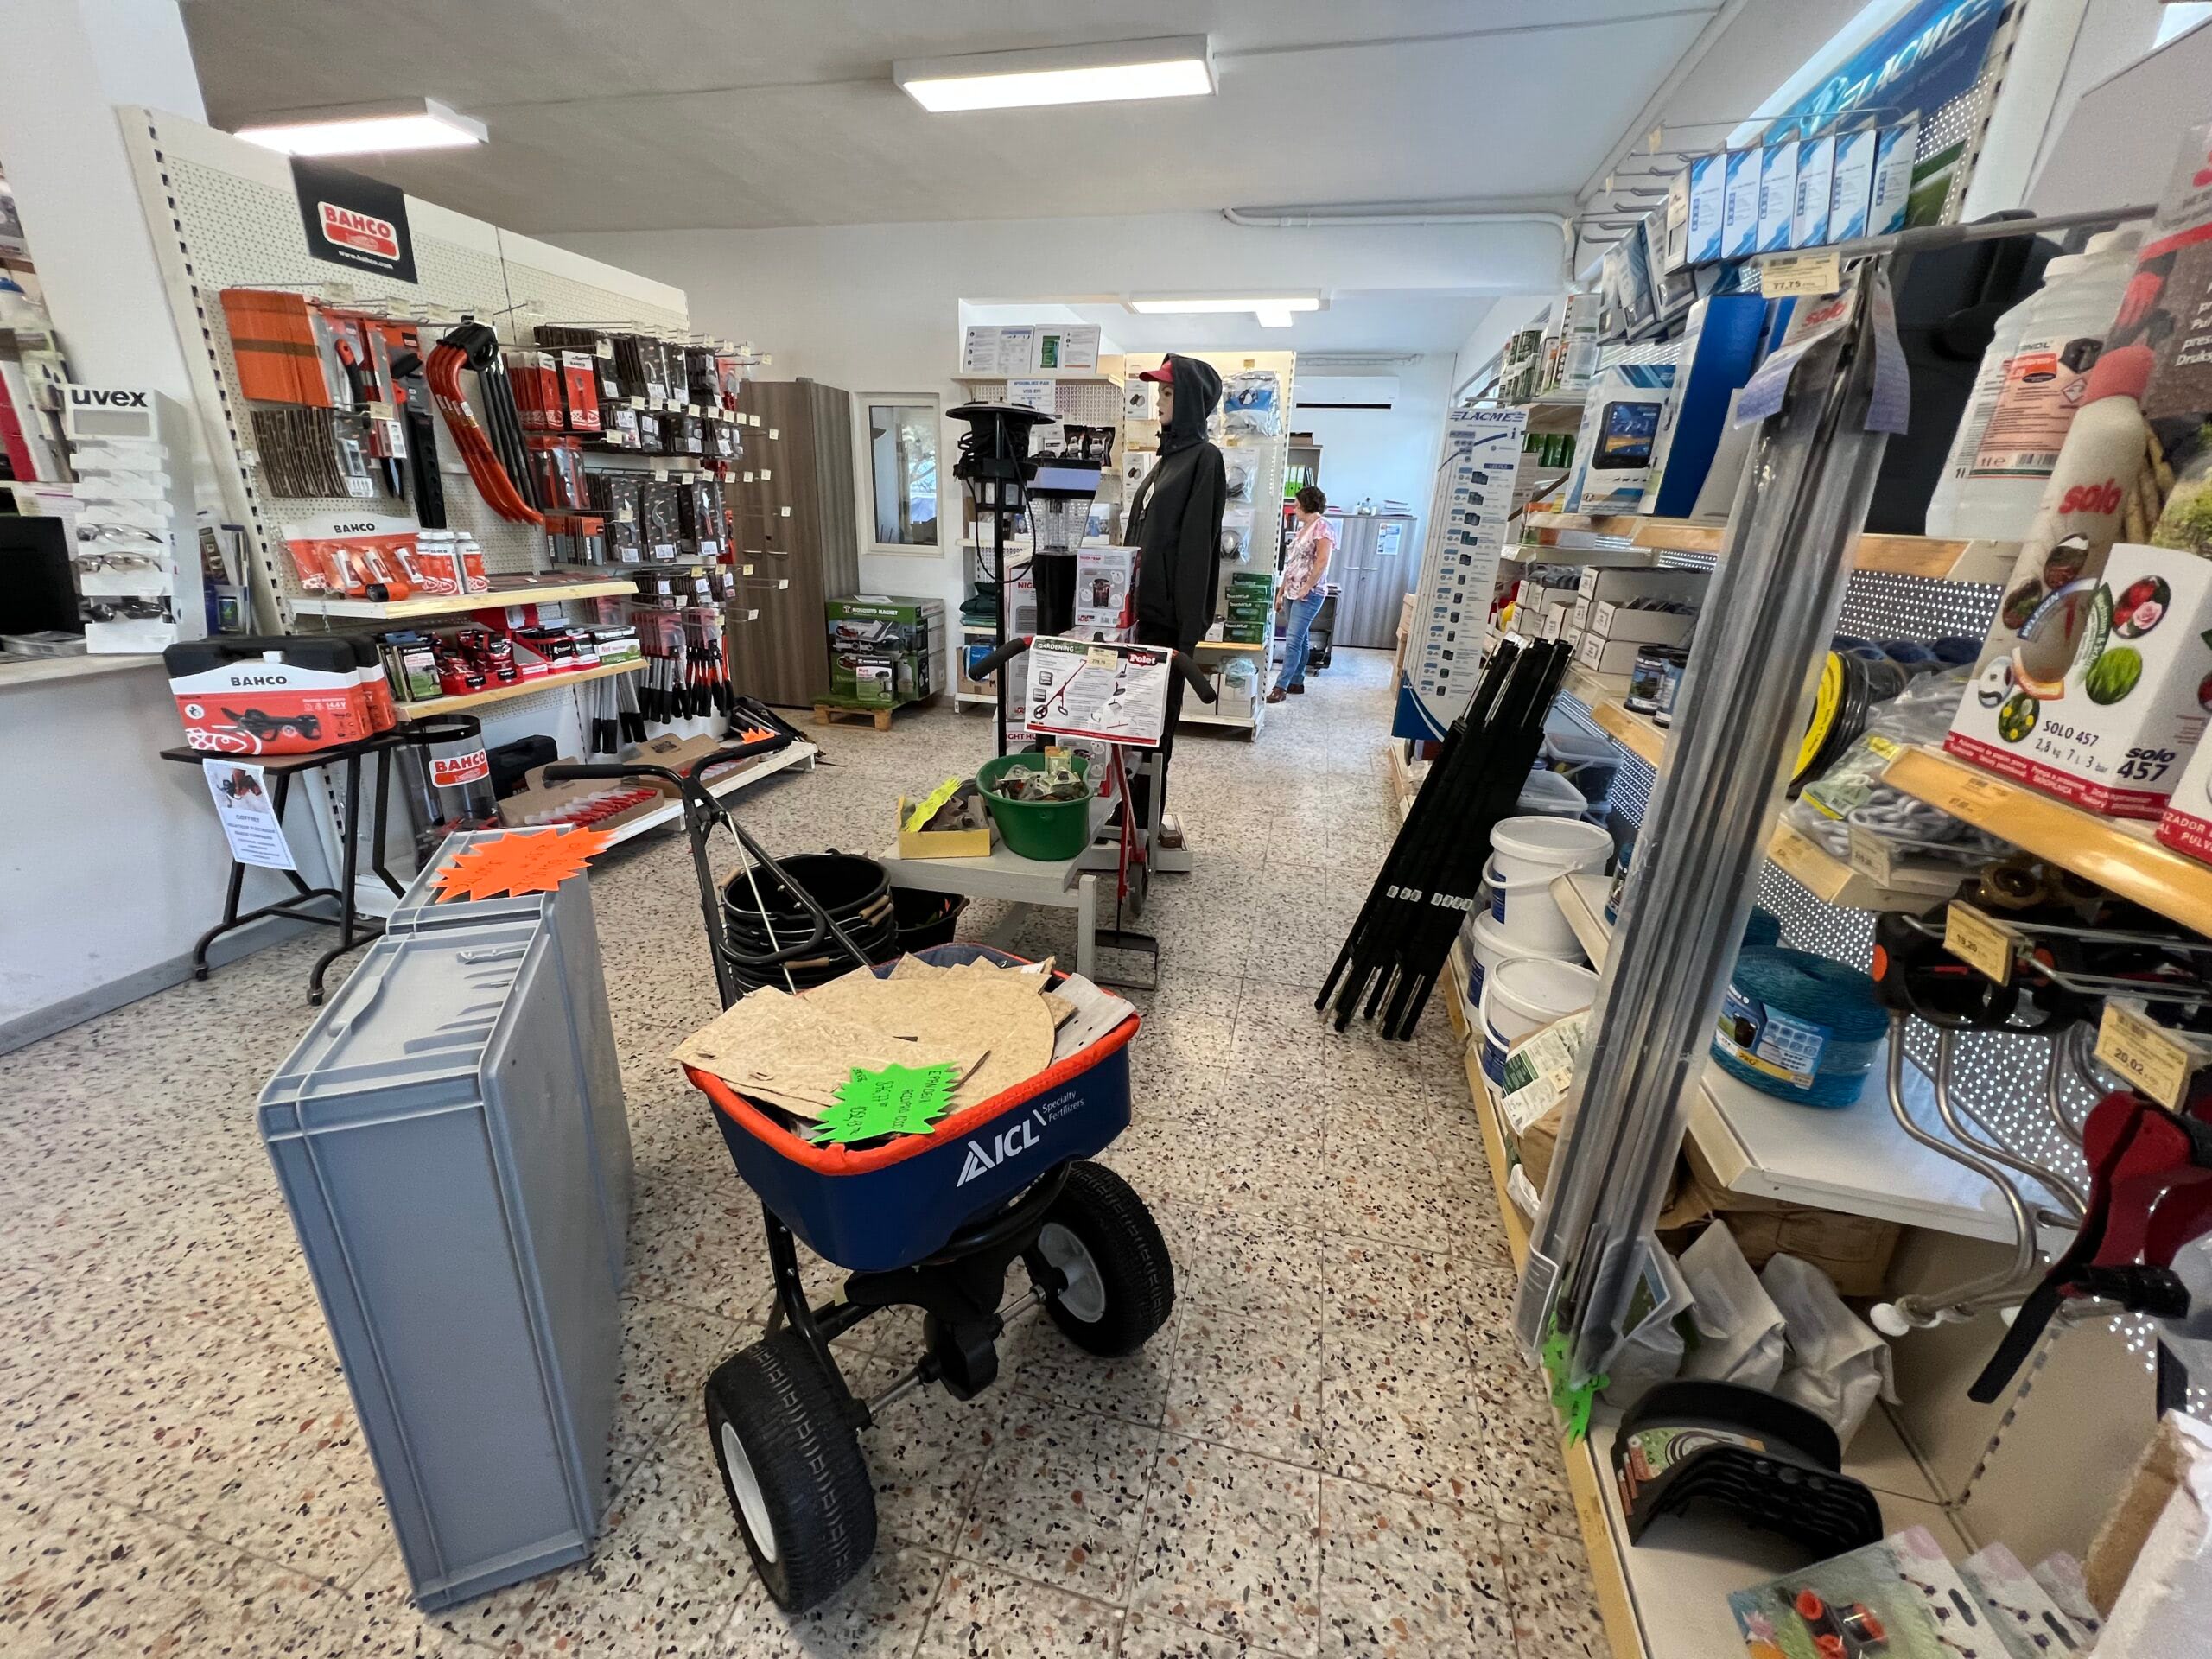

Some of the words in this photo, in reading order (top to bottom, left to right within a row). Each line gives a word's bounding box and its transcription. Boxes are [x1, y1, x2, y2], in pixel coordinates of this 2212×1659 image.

[323, 206, 391, 238] BAHCO
[2181, 335, 2212, 353] pres
[72, 389, 148, 407] uvex
[1460, 411, 1514, 422] LACME
[2058, 478, 2122, 515] solo
[334, 523, 376, 534] BAHCO
[1037, 642, 1075, 653] GARDENING
[1129, 653, 1157, 664] Polet
[230, 677, 289, 688] BAHCO
[2043, 720, 2075, 740] SOLO
[2075, 731, 2100, 747] 457
[435, 750, 486, 772] BAHCO
[2035, 738, 2051, 753] 2,8
[2067, 749, 2075, 761] 7
[2085, 755, 2094, 768] 3
[2125, 747, 2177, 763] solo
[2116, 760, 2171, 782] 457
[2163, 810, 2206, 835] IZADOR
[2181, 831, 2212, 850] PULV
[1042, 1090, 1077, 1114] Specialty
[1048, 1098, 1084, 1122] Fertilizers
